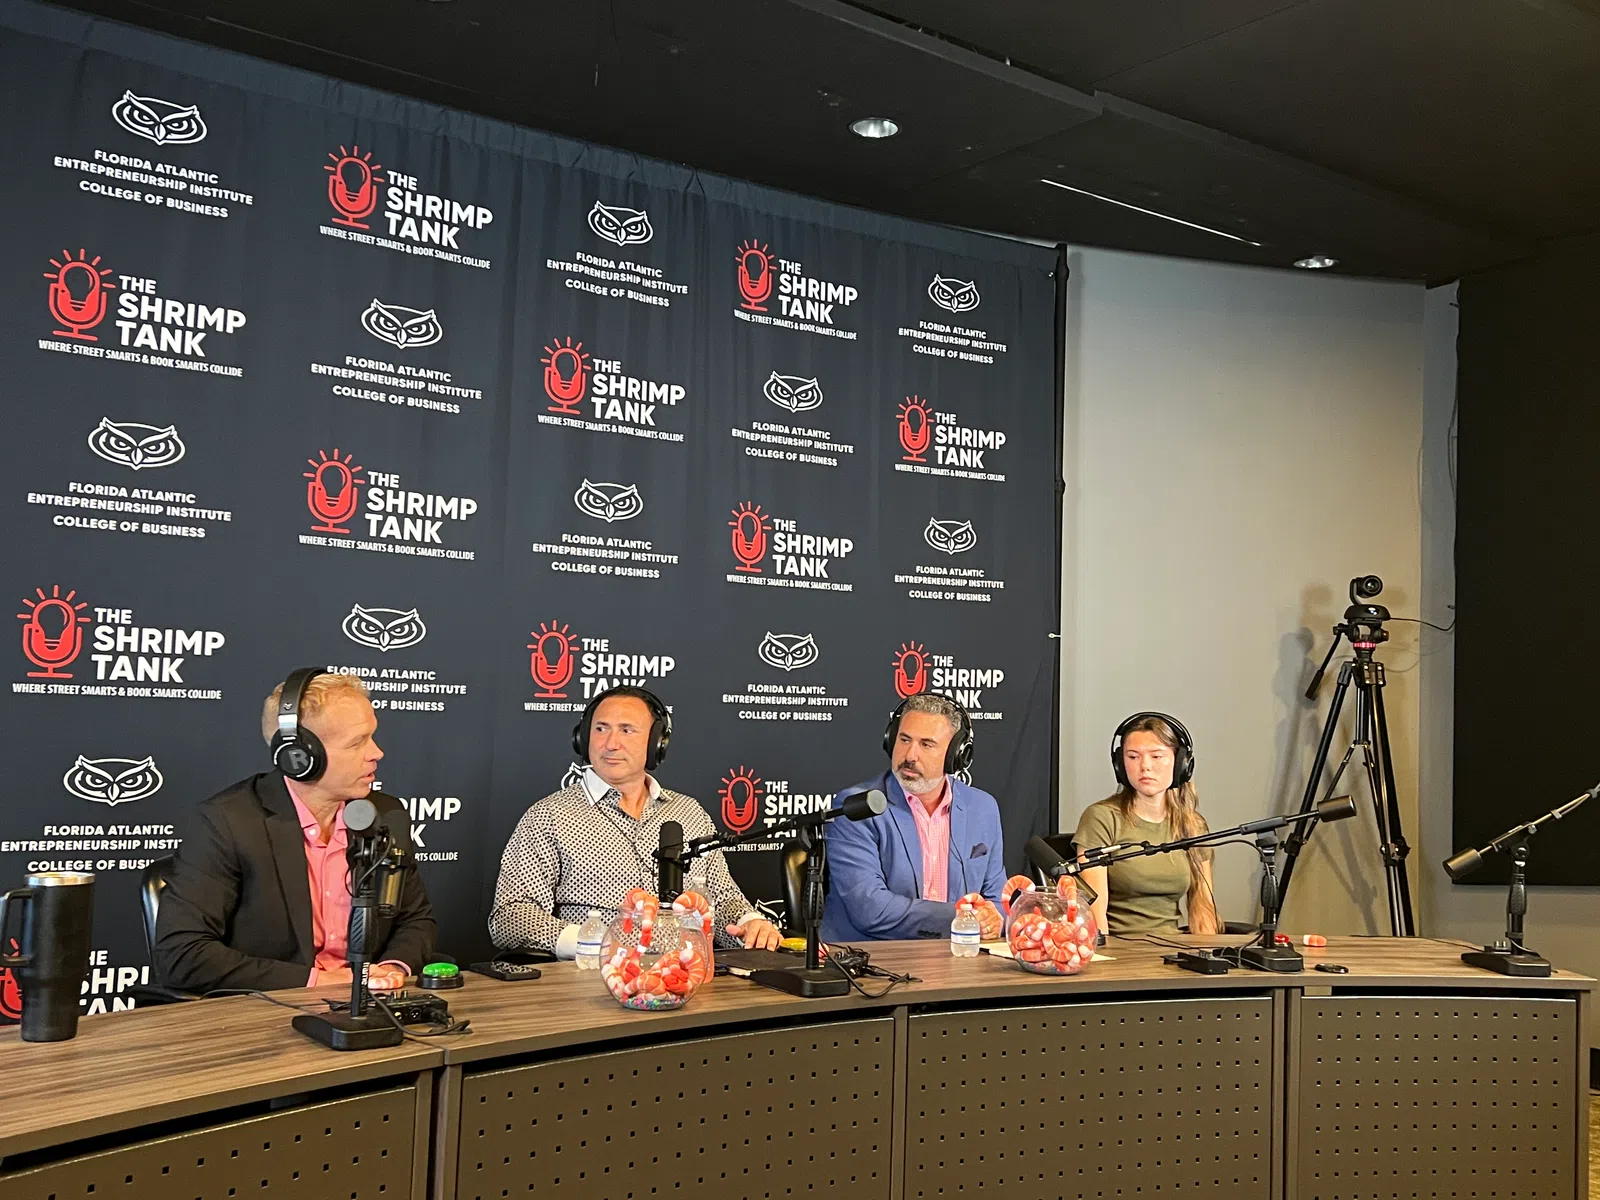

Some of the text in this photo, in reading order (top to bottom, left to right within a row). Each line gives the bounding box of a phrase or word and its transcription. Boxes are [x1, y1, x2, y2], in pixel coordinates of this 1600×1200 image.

[95, 150, 218, 184] FLORIDA ATLANTIC
[54, 156, 253, 205] ENTREPRENEURSHIP INSTITUTE
[387, 170, 417, 191] THE
[79, 180, 228, 217] COLLEGE OF BUSINESS
[386, 187, 493, 229] SHRIMP
[384, 211, 460, 249] TANK
[320, 225, 347, 239] WHERE
[348, 232, 376, 245] STREET
[376, 237, 405, 252] SMARTS
[413, 246, 434, 257] BOOK
[434, 249, 462, 263] SMARTS
[462, 256, 490, 269] COLLIDE
[576, 252, 662, 278] FLORIDA ATLANTIC
[779, 259, 801, 275] THE
[119, 275, 156, 294] THE
[547, 259, 688, 294] ENTREPRENEURSHIP INSTITUTE
[565, 279, 669, 307] COLLEGE OF BUSINESS
[779, 273, 858, 306] SHRIMP
[117, 293, 246, 334] SHRIMP
[778, 294, 833, 324] TANK
[115, 320, 206, 357] TANK
[898, 328, 1006, 352] ENTREPRENEURSHIP INSTITUTE
[919, 321, 986, 339] FLORIDA ATLANTIC
[38, 339, 72, 353] WHERE
[72, 344, 105, 357] STREET
[105, 349, 141, 362] SMARTS
[150, 355, 174, 368] BOOK
[175, 359, 209, 372] SMARTS
[209, 364, 243, 377] COLLIDE
[913, 344, 993, 364] COLLEGE OF BUSINESS
[346, 356, 451, 382] FLORIDA ATLANTIC
[593, 358, 621, 374] THE
[311, 363, 482, 399] ENTREPRENEURSHIP INSTITUTE
[592, 373, 685, 405] SHRIMP
[333, 385, 460, 414] COLLEGE OF BUSINESS
[591, 397, 655, 426] TANK
[935, 412, 956, 425] THE
[538, 415, 562, 425] WHERE
[563, 418, 585, 428] STREET
[585, 422, 611, 432] SMARTS
[618, 425, 635, 435] BOOK
[634, 428, 658, 439] SMARTS
[658, 432, 684, 442] COLLIDE
[753, 422, 830, 439] FLORIDA ATLANTIC
[935, 425, 1006, 450] SHRIMP
[732, 428, 853, 453] ENTREPRENEURSHIP INSTITUTE
[745, 447, 837, 466] COLLEGE OF BUSINESS
[934, 446, 984, 469] TANK
[368, 471, 400, 488] THE
[69, 482, 196, 504] FLORIDA ATLANTIC
[366, 487, 477, 520] SHRIMP
[27, 493, 231, 521] ENTREPRENEURSHIP INSTITUTE
[53, 515, 205, 538] COLLEGE OF BUSINESS
[365, 513, 443, 544] TANK
[773, 518, 796, 532] THE
[299, 535, 327, 546] WHERE
[328, 538, 356, 549] STREET
[356, 541, 387, 552] SMARTS
[395, 545, 416, 555] BOOK
[416, 547, 445, 557] SMARTS
[446, 550, 475, 560] COLLIDE
[562, 534, 652, 550] FLORIDA ATLANTIC
[773, 532, 853, 558] SHRIMP
[533, 543, 678, 564] ENTREPRENEURSHIP INSTITUTE
[551, 561, 660, 578] COLLEGE OF BUSINESS
[772, 554, 828, 578] TANK
[916, 565, 984, 577] FLORIDA ATLANTIC
[894, 575, 1004, 589] ENTREPRENEURSHIP INSTITUTE
[909, 590, 991, 602] COLLEGE OF BUSINESS
[94, 607, 132, 624] THE
[93, 625, 225, 656] SHRIMP
[581, 638, 609, 652] THE
[91, 654, 184, 683] TANK
[580, 653, 676, 677] SHRIMP
[932, 655, 954, 667] THE
[327, 666, 436, 680] FLORIDA ATLANTIC
[932, 668, 1005, 688] SHRIMP
[12, 683, 46, 694] WHERE
[47, 684, 80, 694] STREET
[81, 685, 117, 696] SMARTS
[127, 687, 151, 697] BOOK
[152, 688, 187, 698] SMARTS
[188, 689, 221, 699] COLLIDE
[411, 684, 467, 695] INSTITUTE
[722, 694, 848, 706] ENTREPRENEURSHIP INSTITUTE
[748, 684, 826, 695] FLORIDA ATLANTIC
[372, 700, 445, 711] OF BUSINESS
[524, 703, 548, 711] WHERE
[548, 703, 572, 712] STREET
[739, 710, 832, 721] COLLEGE OF BUSINESS
[288, 749, 309, 770] R
[764, 781, 788, 793] THE
[764, 794, 837, 815] SHRIM
[44, 825, 174, 836] FLORIDA ATLANTIC
[1, 840, 141, 852] ENTREPRENEURSHIP
[429, 852, 459, 861] COLLIDE
[27, 860, 93, 871] COLLEGE
[96, 860, 116, 870] OF
